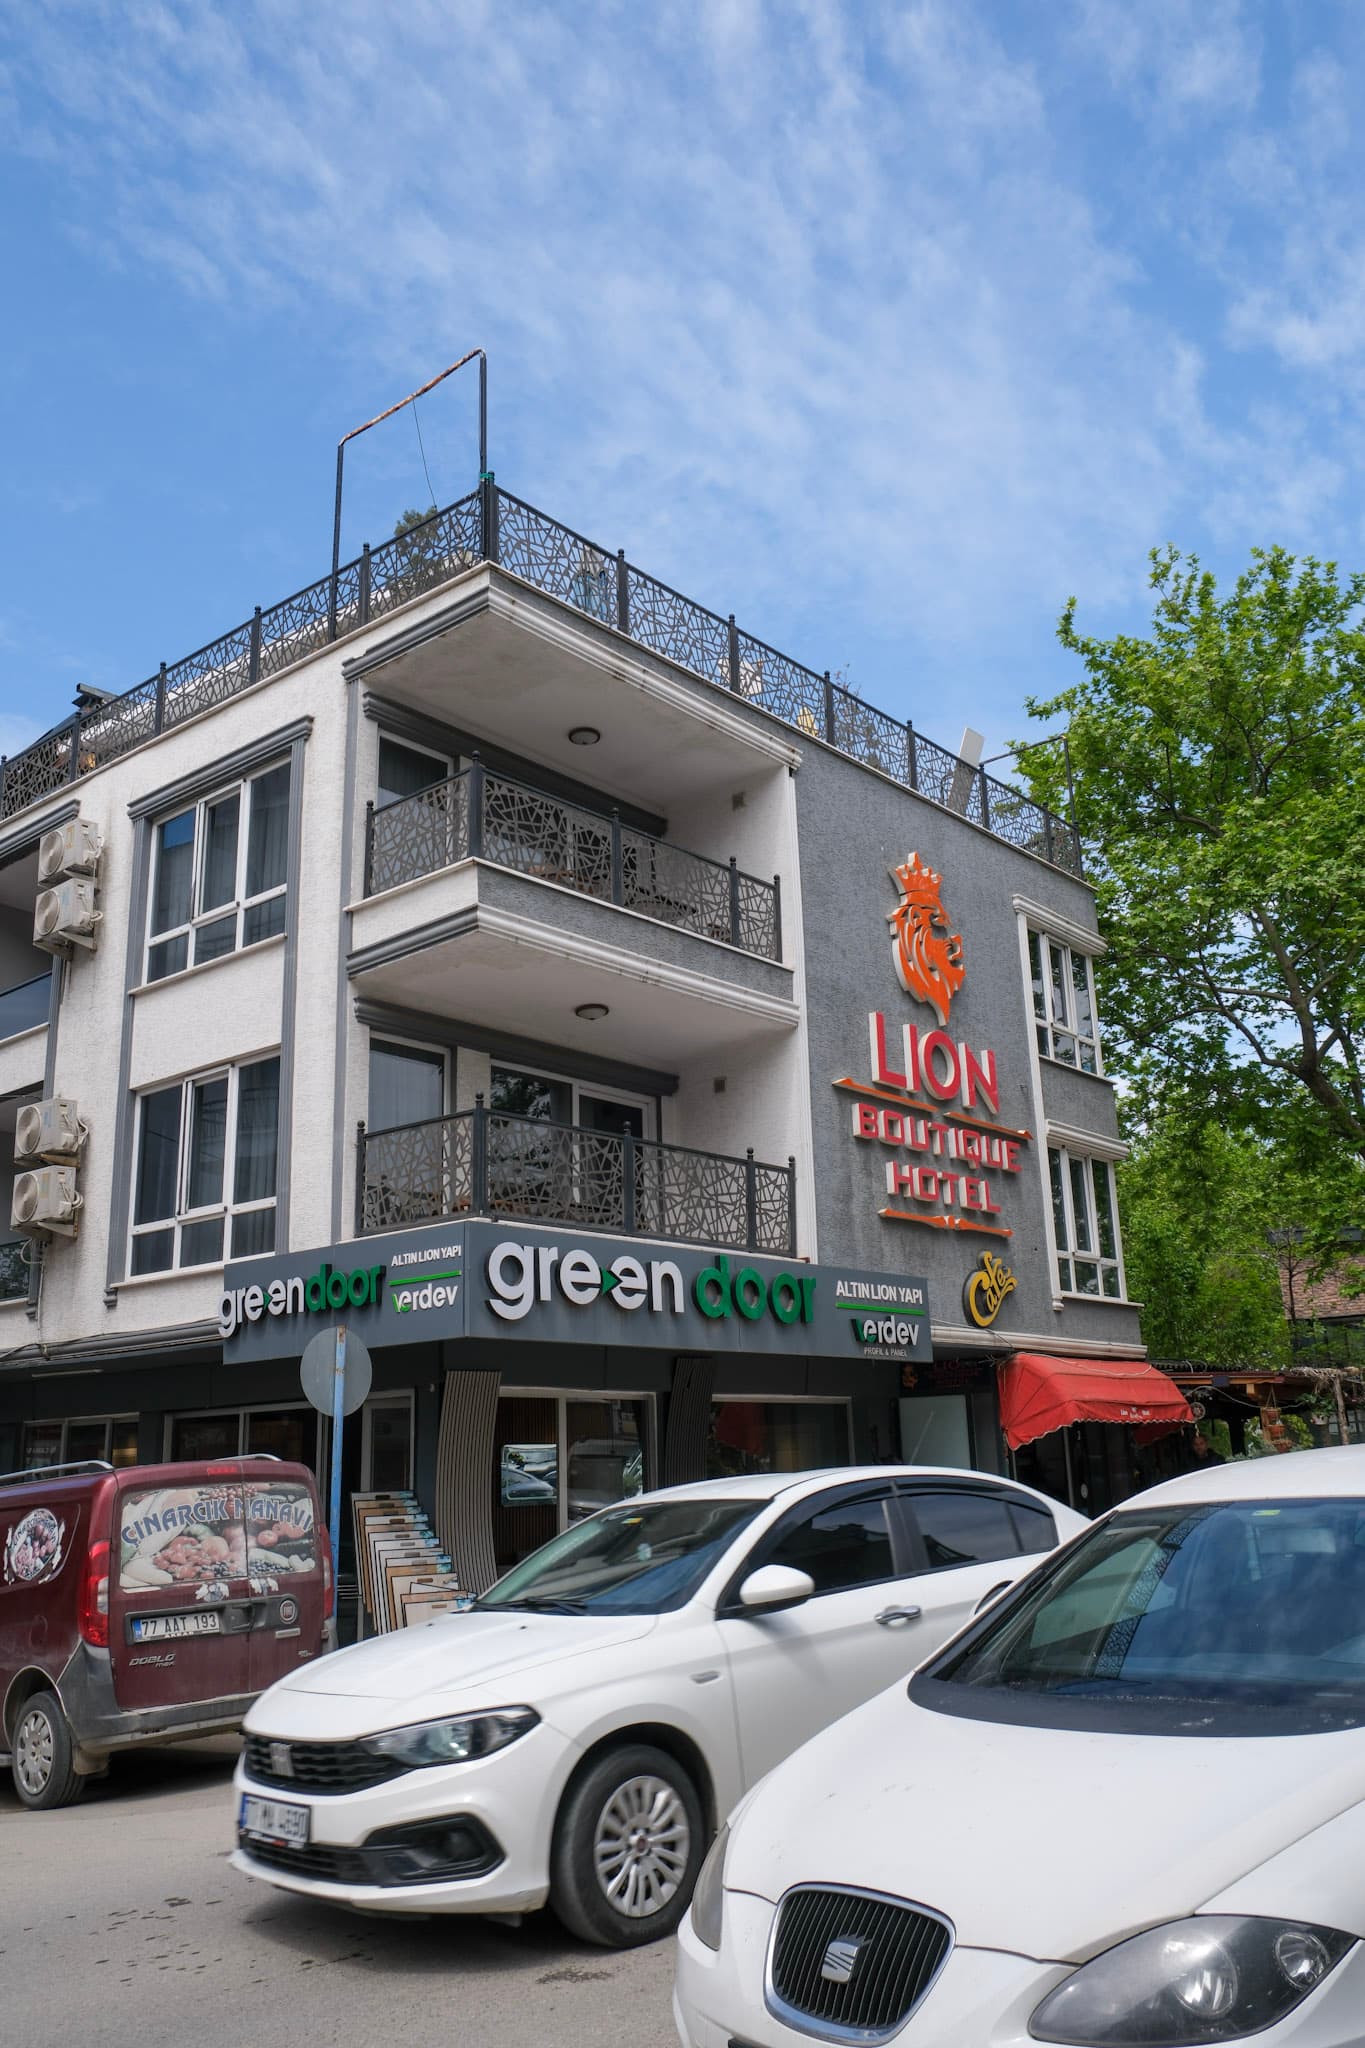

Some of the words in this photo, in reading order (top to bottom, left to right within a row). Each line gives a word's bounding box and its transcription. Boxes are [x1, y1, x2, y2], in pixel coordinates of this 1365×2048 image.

[868, 1011, 1000, 1115] LION
[852, 1102, 1023, 1174] BOUTIQUE
[885, 1161, 1002, 1214] HOTEL
[391, 1252, 417, 1267] ALTIN
[418, 1248, 440, 1262] LION
[440, 1245, 462, 1258] YAPI
[489, 1241, 685, 1321] green
[695, 1254, 817, 1325] door
[836, 1280, 870, 1299] ALTIN
[871, 1284, 897, 1301] LION
[898, 1287, 923, 1304] YAPI
[141, 1620, 158, 1636] 77
[164, 1616, 188, 1632] AAT
[194, 1614, 217, 1629] 193
